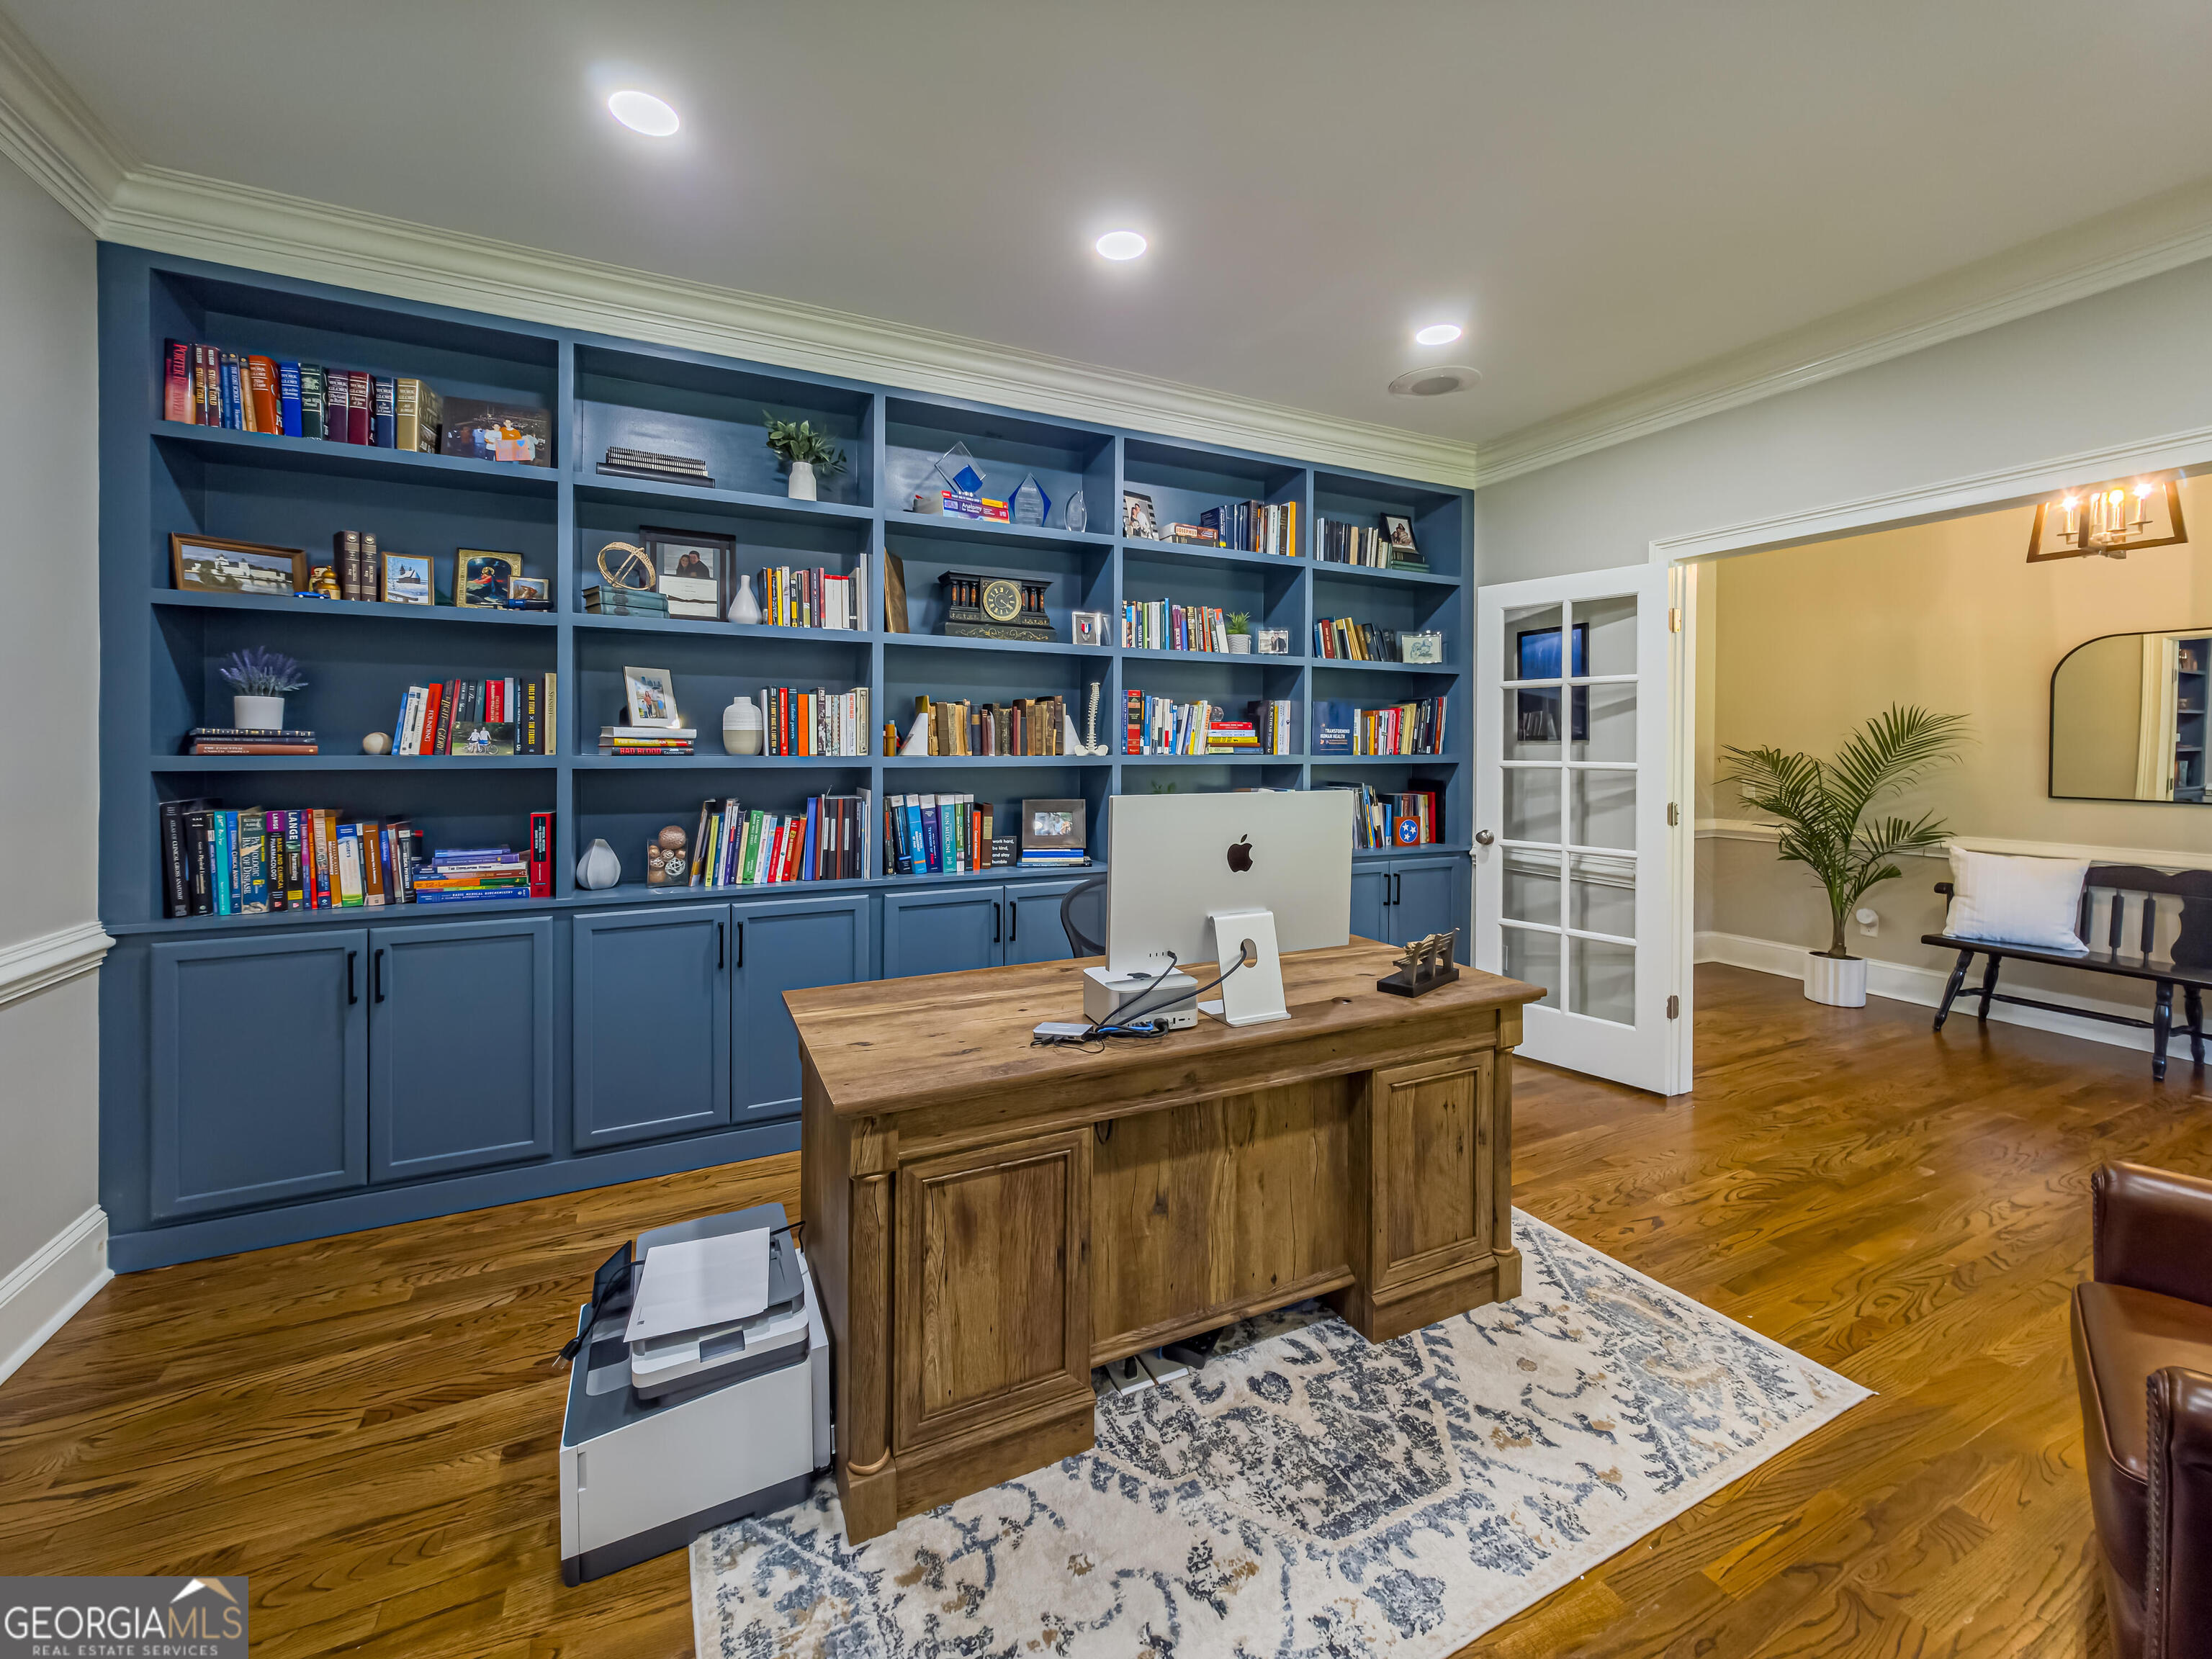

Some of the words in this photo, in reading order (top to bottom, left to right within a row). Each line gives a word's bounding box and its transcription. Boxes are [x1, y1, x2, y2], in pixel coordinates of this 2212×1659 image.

[173, 343, 188, 376] PORTER
[962, 503, 982, 512] Anatomy
[289, 812, 299, 840] LANGE
[251, 836, 261, 877] PAOLOGIC
[243, 866, 252, 894] DISEASE
